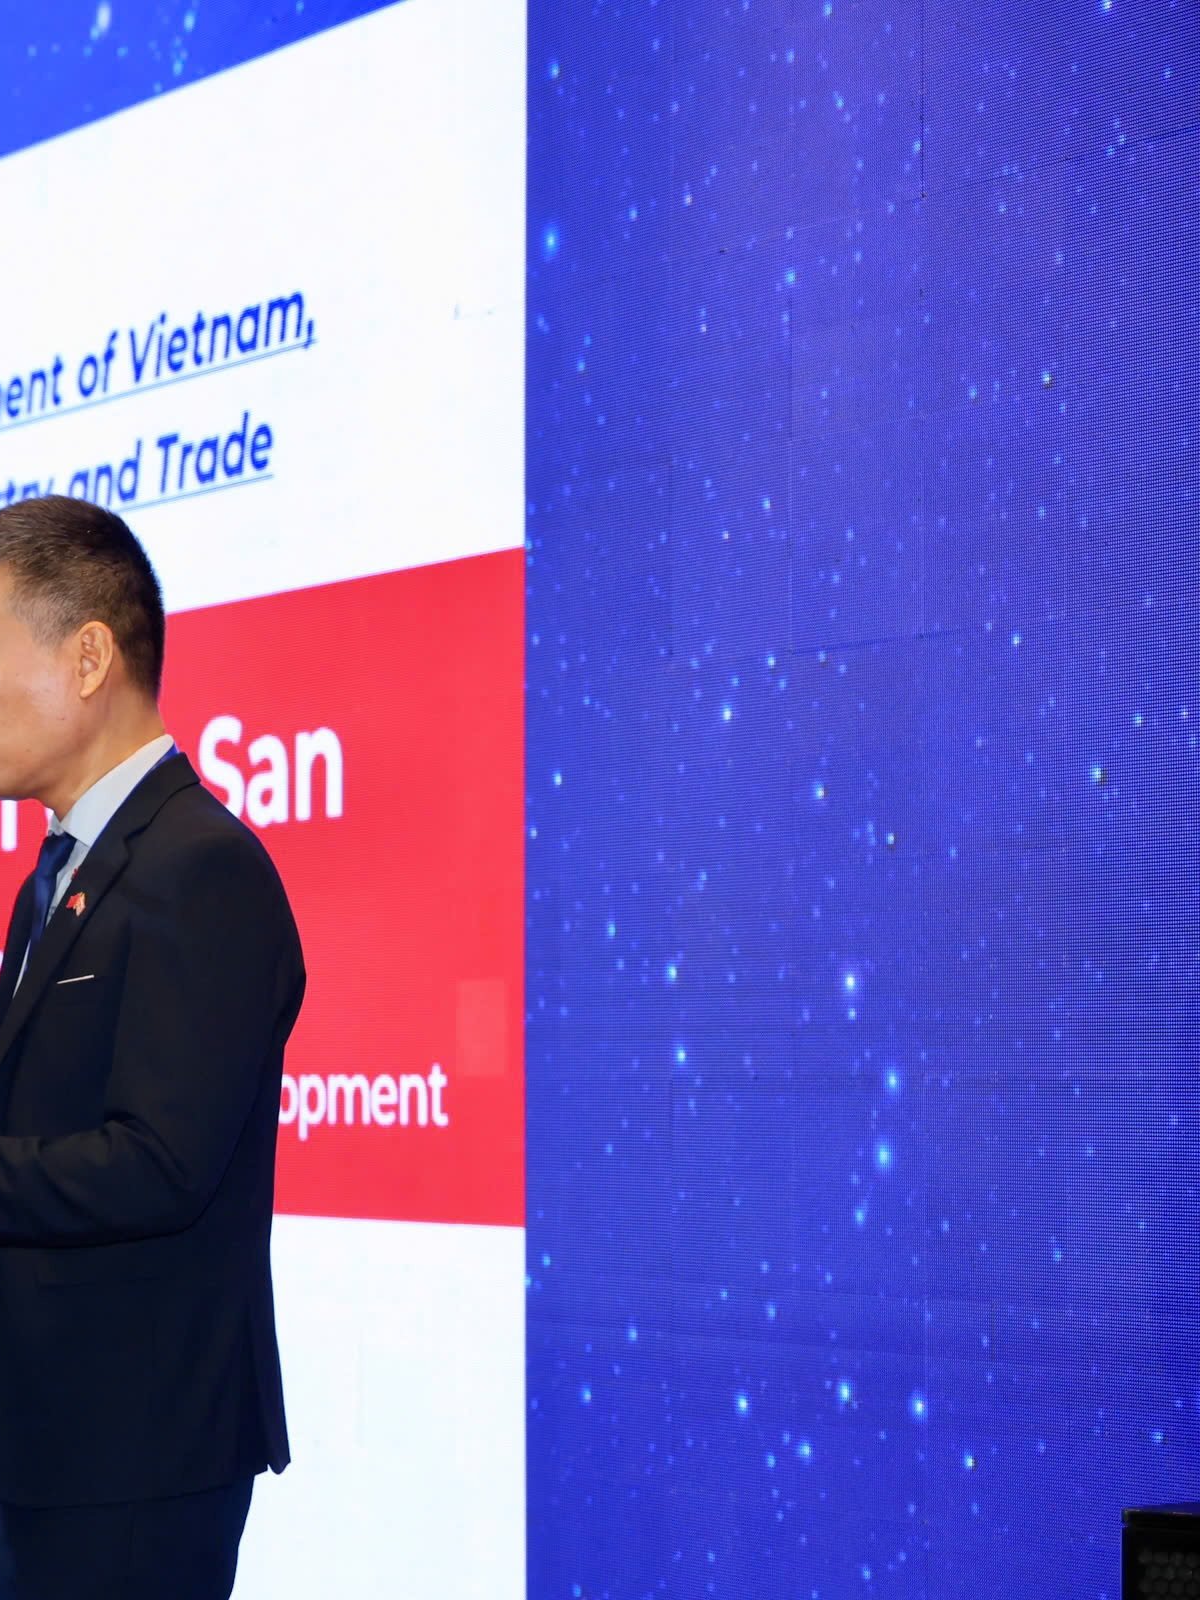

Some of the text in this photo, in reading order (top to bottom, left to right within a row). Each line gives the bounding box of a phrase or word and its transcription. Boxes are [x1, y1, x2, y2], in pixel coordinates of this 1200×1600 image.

[78, 329, 119, 397] of
[129, 290, 315, 384] Vietnam,
[68, 439, 142, 508] and
[156, 410, 273, 495] Trade
[199, 714, 344, 828] San
